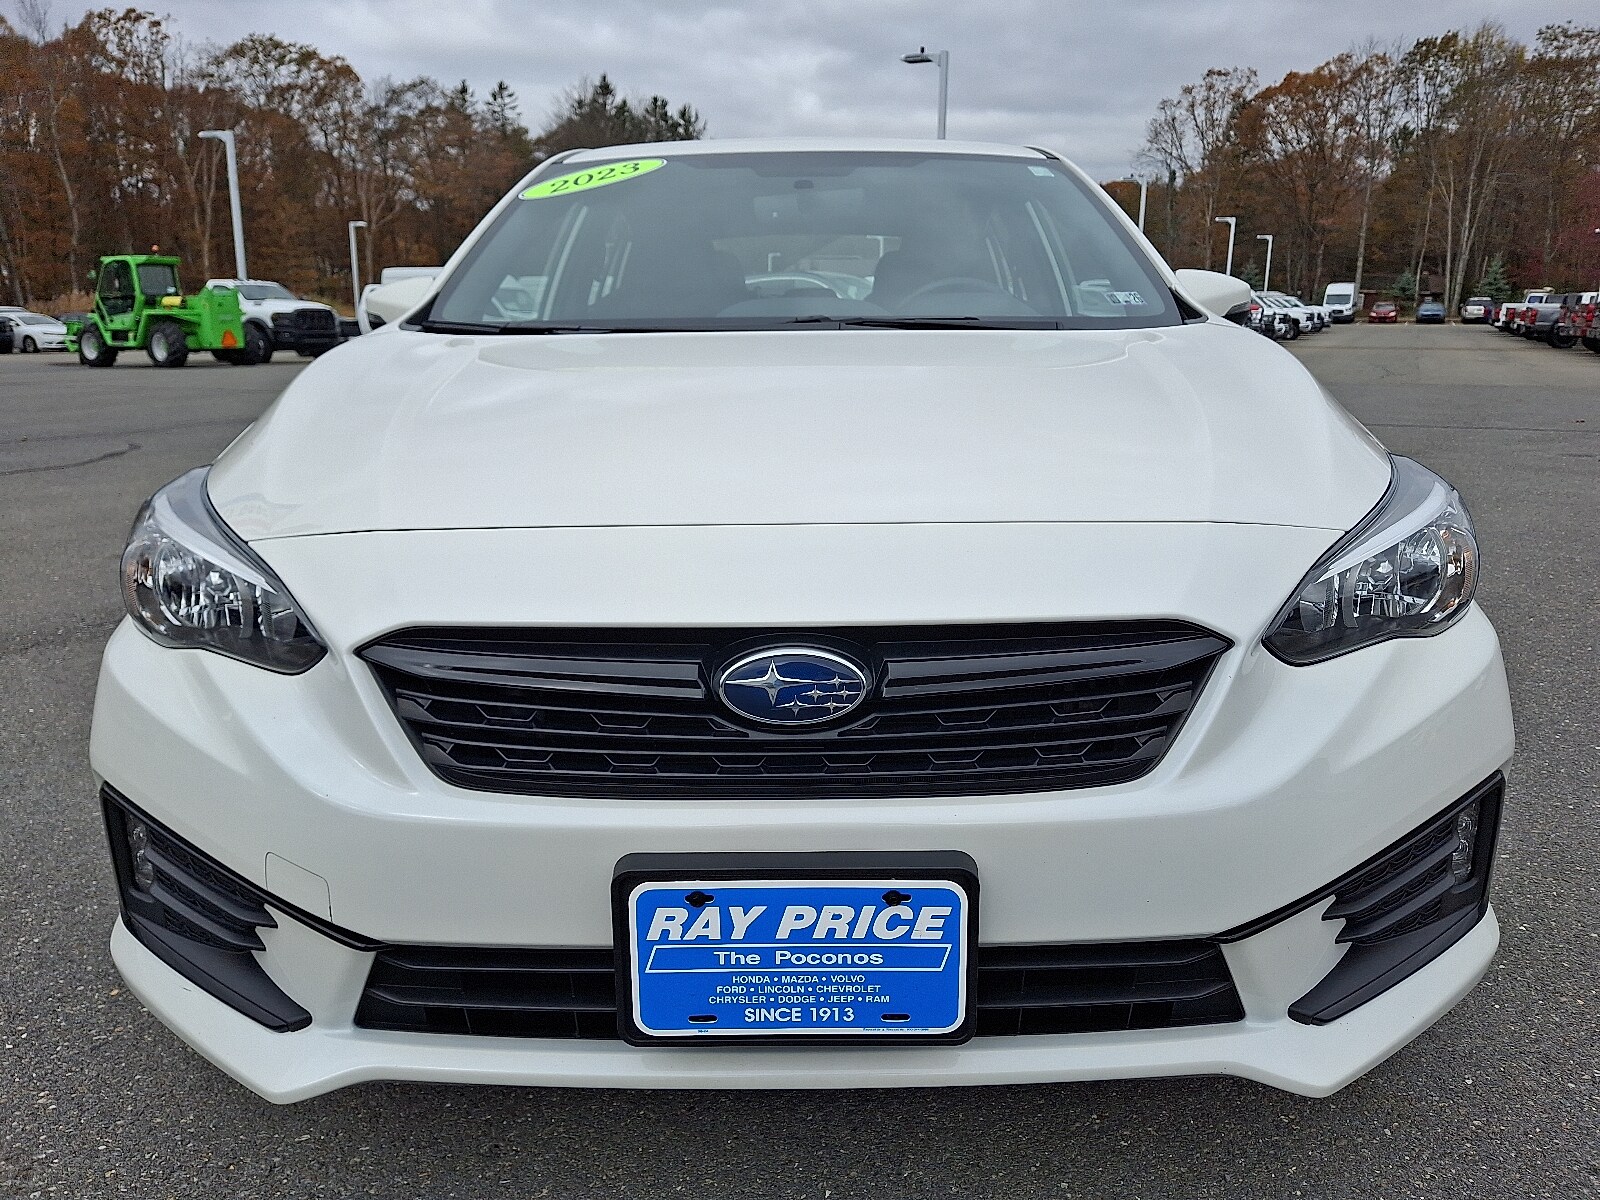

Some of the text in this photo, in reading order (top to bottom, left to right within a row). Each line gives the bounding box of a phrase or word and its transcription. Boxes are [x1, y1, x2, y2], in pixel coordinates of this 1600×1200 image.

[550, 162, 640, 193] 2023
[646, 904, 952, 940] RAY PRICE
[713, 950, 884, 965] The Poconos
[732, 974, 866, 984] HONDA MAZDA VOLVO
[716, 984, 882, 994] FORD LINCOLN CHEVROLET
[708, 995, 890, 1005] CHRYSLER DODGE JEEP RAM
[744, 1007, 855, 1023] SINCE 1913
